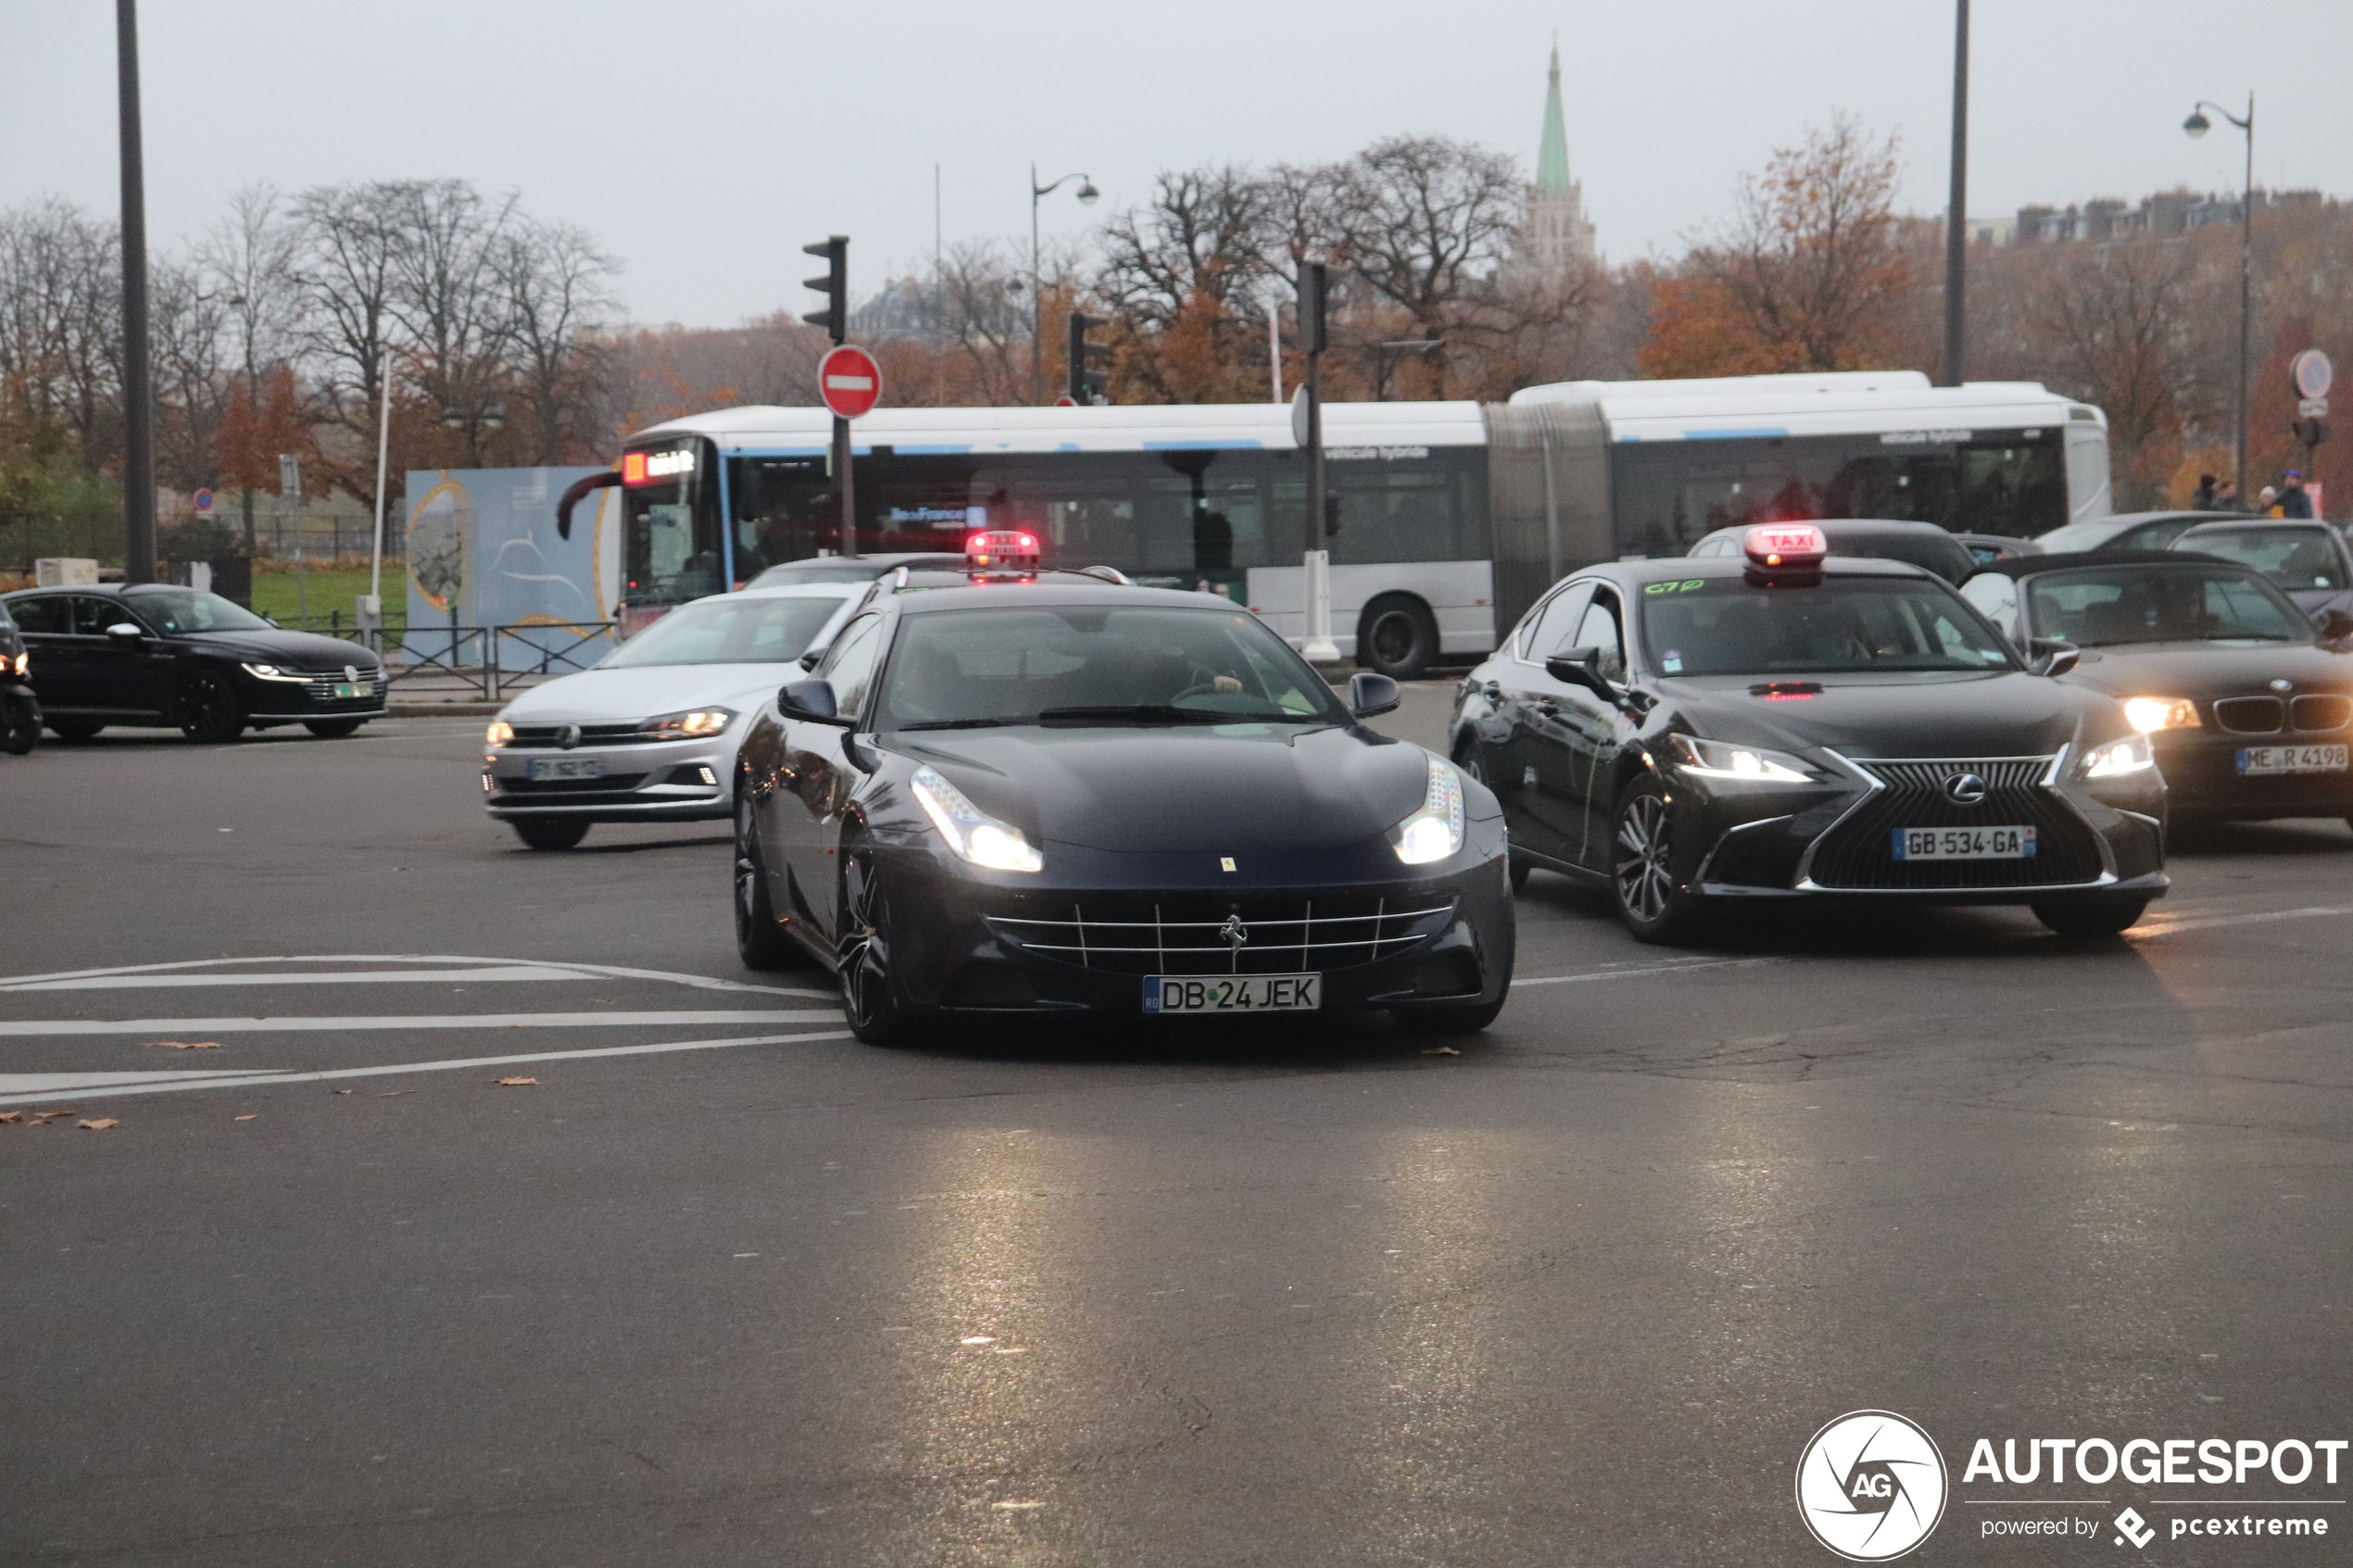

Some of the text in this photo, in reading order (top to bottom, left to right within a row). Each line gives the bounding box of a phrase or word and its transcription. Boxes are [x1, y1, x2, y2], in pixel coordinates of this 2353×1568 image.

[1768, 534, 1814, 546] TAXI
[1645, 581, 1680, 594] G7
[2247, 746, 2346, 768] ME R 4198
[1908, 831, 2019, 855] GB-534-GA
[1163, 978, 1315, 1010] DB 24 JEK
